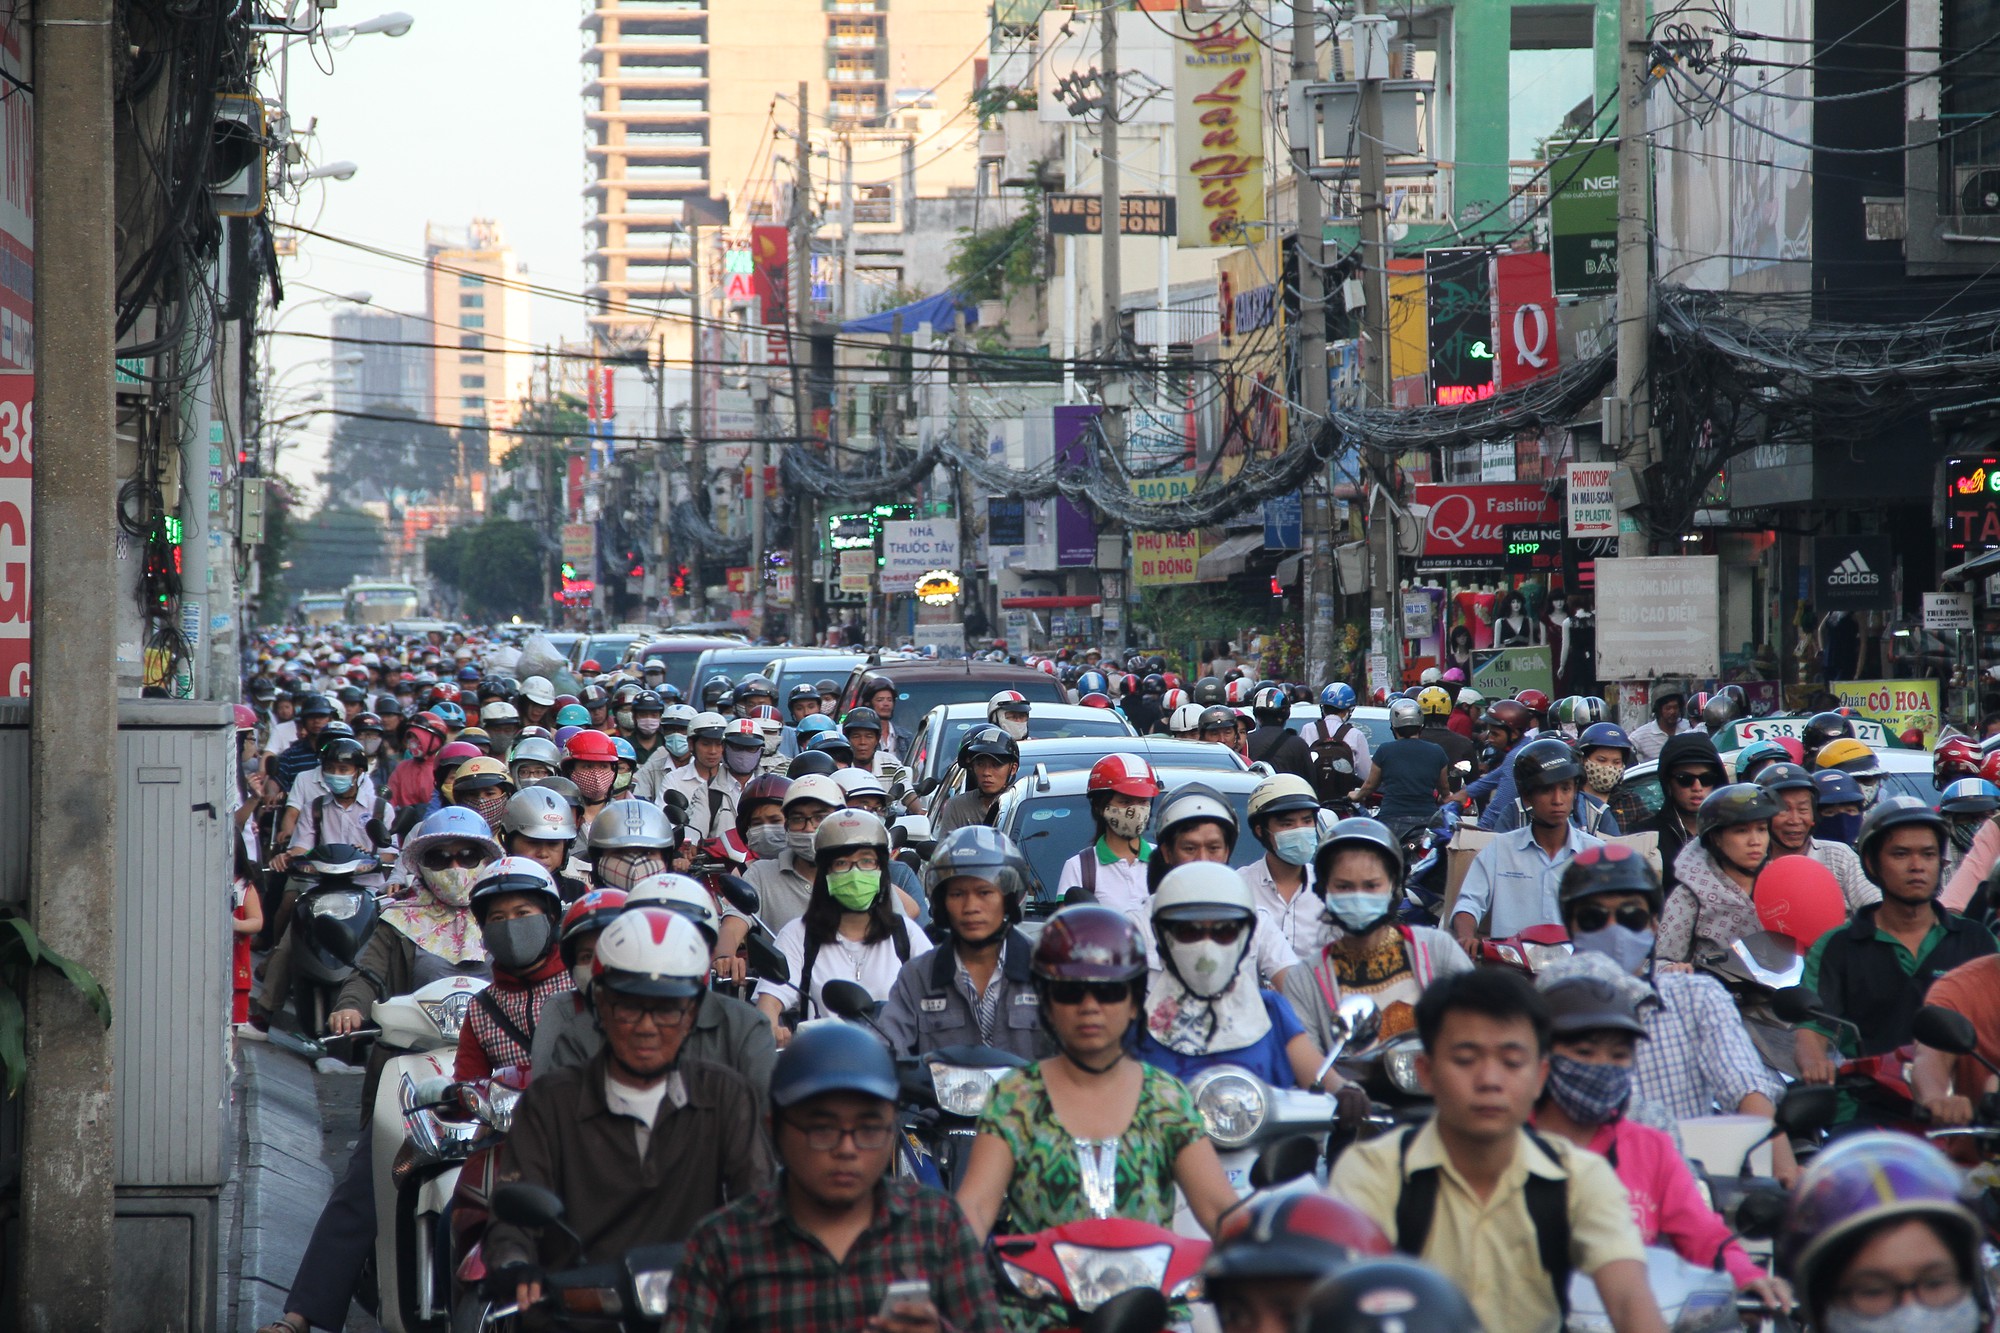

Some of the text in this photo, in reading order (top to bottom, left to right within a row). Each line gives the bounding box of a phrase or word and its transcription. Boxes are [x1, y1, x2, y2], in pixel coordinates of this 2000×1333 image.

[1185, 52, 1252, 66] BAKERY
[1051, 199, 1160, 215] WESERN
[1086, 216, 1160, 231] UION
[1513, 303, 1549, 368] Q
[1487, 498, 1547, 512] Fashion
[1572, 493, 1579, 504] IN
[1574, 508, 1612, 521] ÉP PLASTIC
[909, 526, 935, 538] NHÀ
[889, 539, 955, 553] THUỐC TÂY
[1137, 532, 1196, 553] PHỤ KIỆN
[1508, 543, 1540, 555] SHOP
[1142, 557, 1193, 579] DI ĐỘNG
[1828, 573, 1879, 585] adidas
[1641, 606, 1665, 622] CAO
[1479, 678, 1510, 688] SHOP
[1840, 686, 1932, 711] Quán CÔ HOA
[1540, 758, 1567, 769] HONDA
